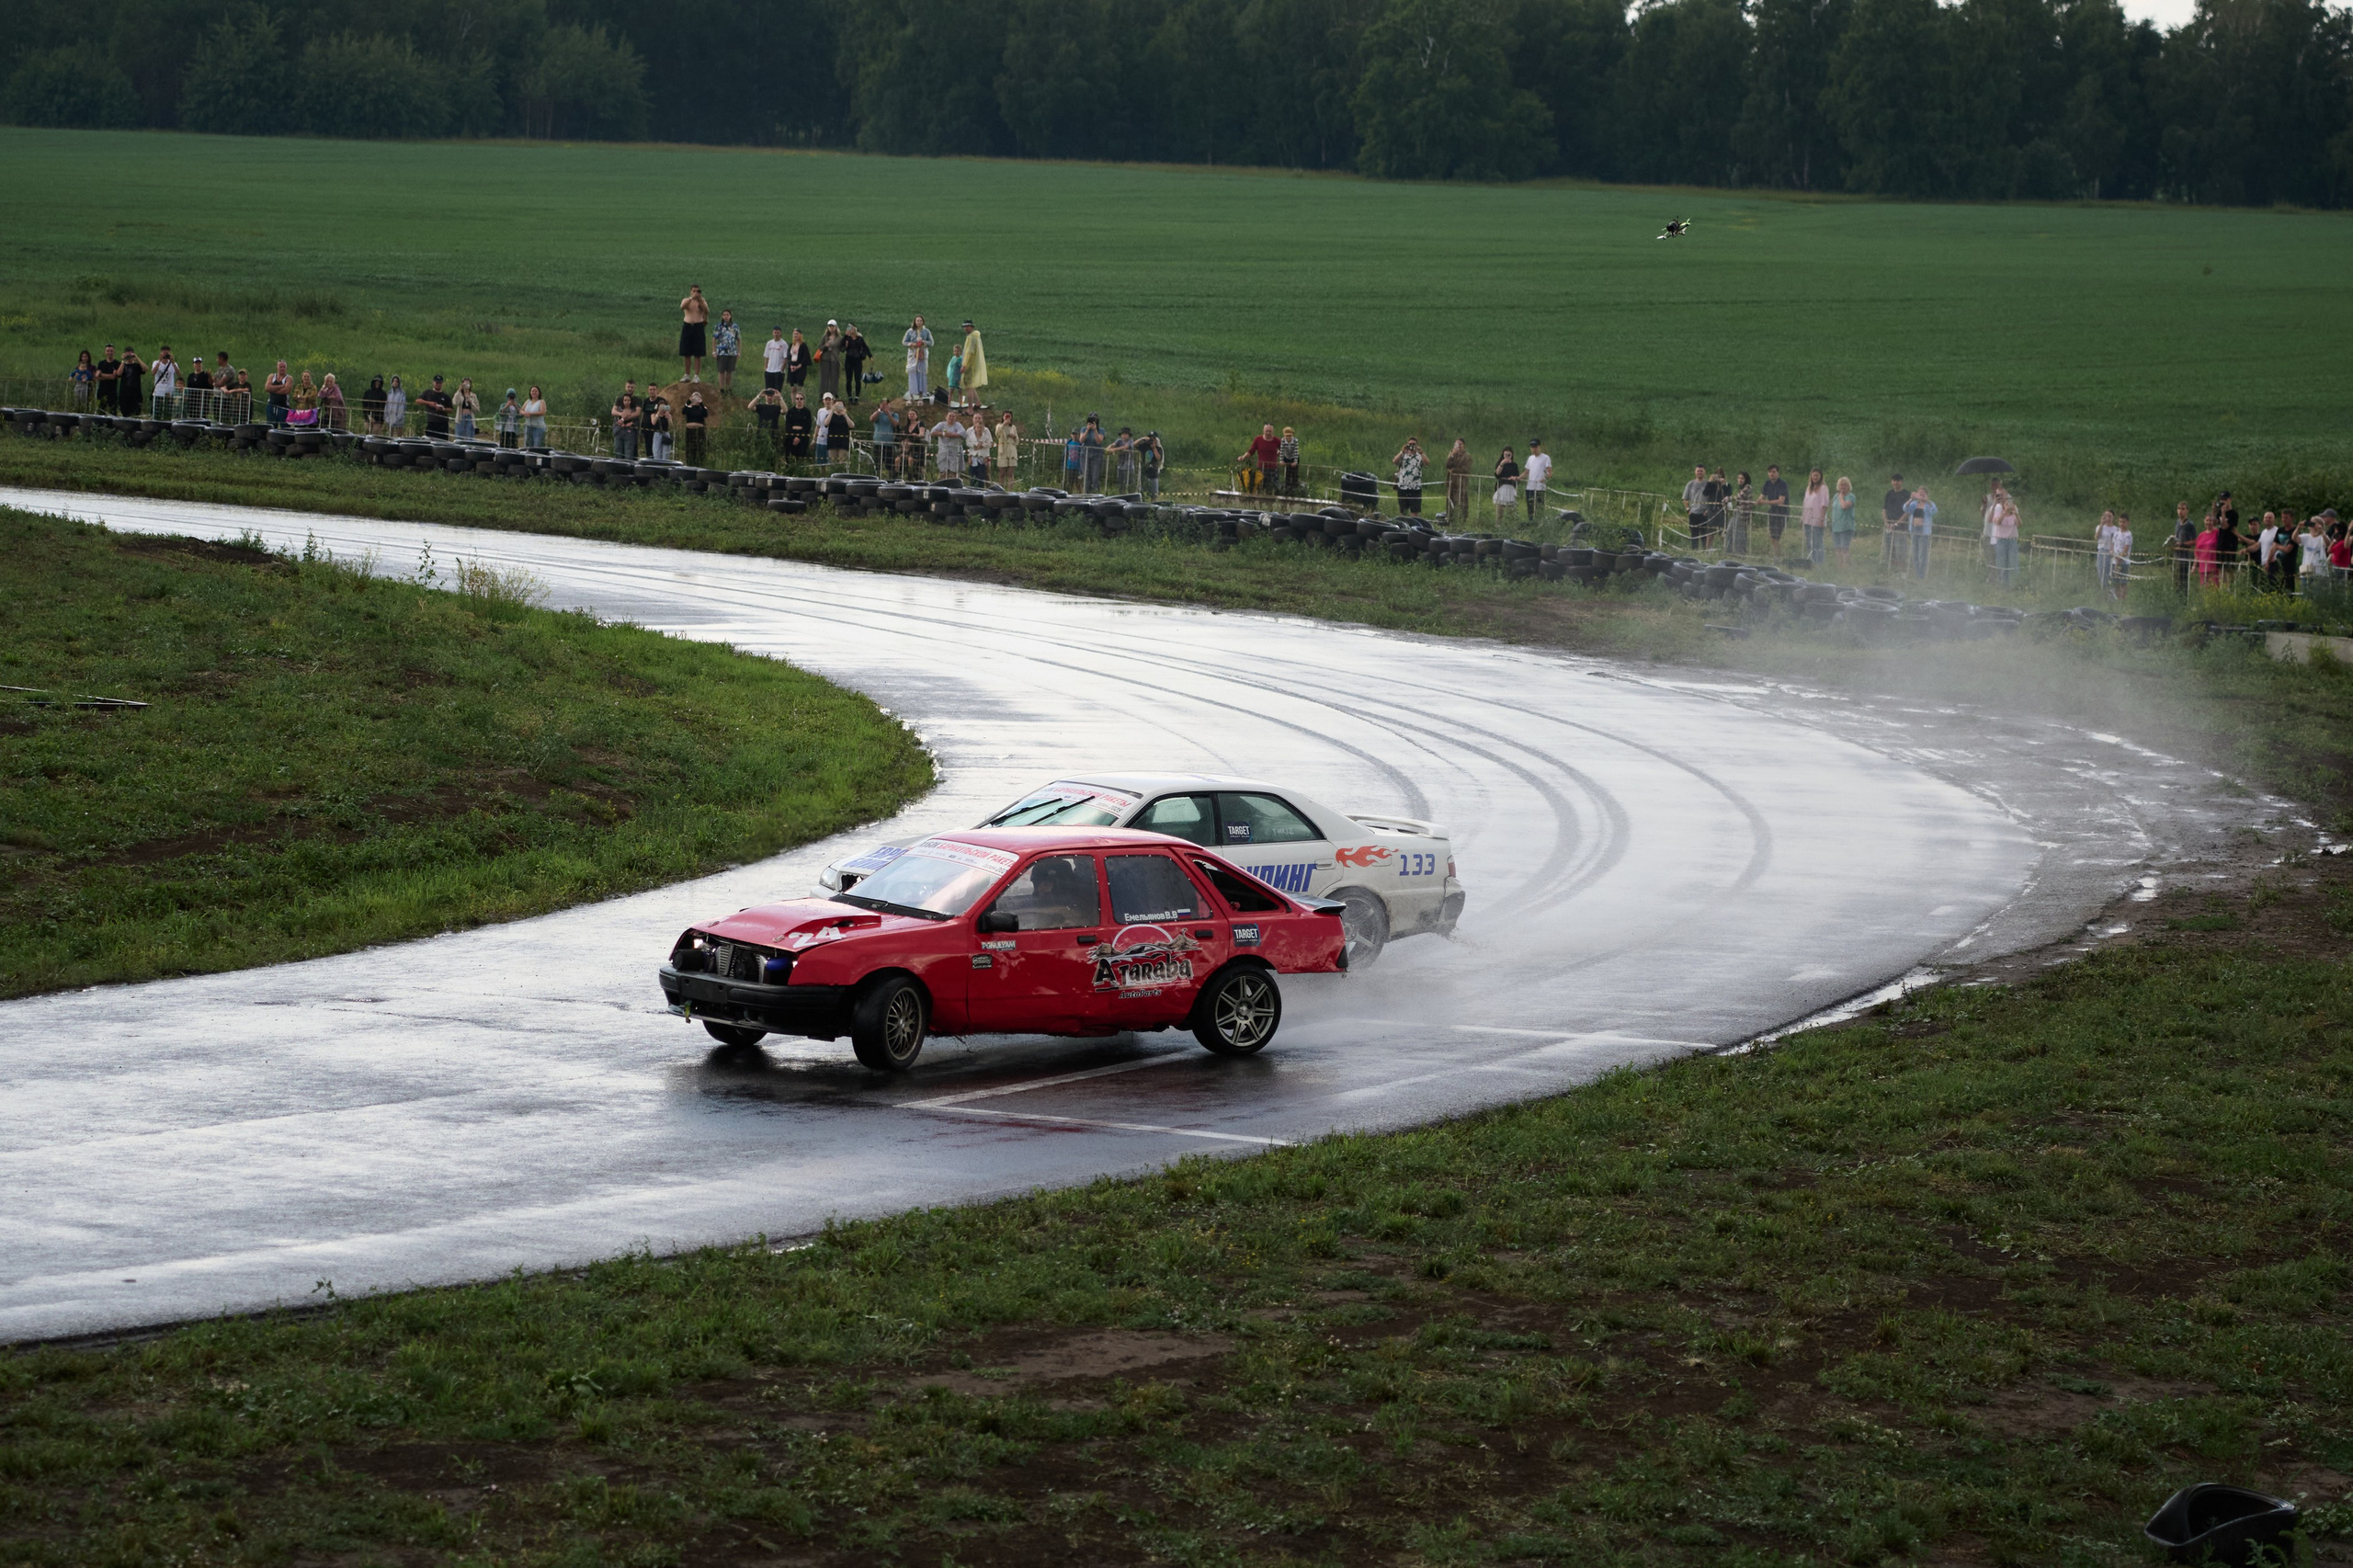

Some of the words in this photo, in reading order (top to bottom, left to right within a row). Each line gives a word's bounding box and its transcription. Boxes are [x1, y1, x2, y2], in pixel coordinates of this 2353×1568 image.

[1227, 825, 1250, 835] TARGET
[1399, 853, 1436, 876] 133
[1124, 912, 1165, 922] Емельянов
[789, 926, 847, 949] 24
[1233, 928, 1258, 939] TARGET
